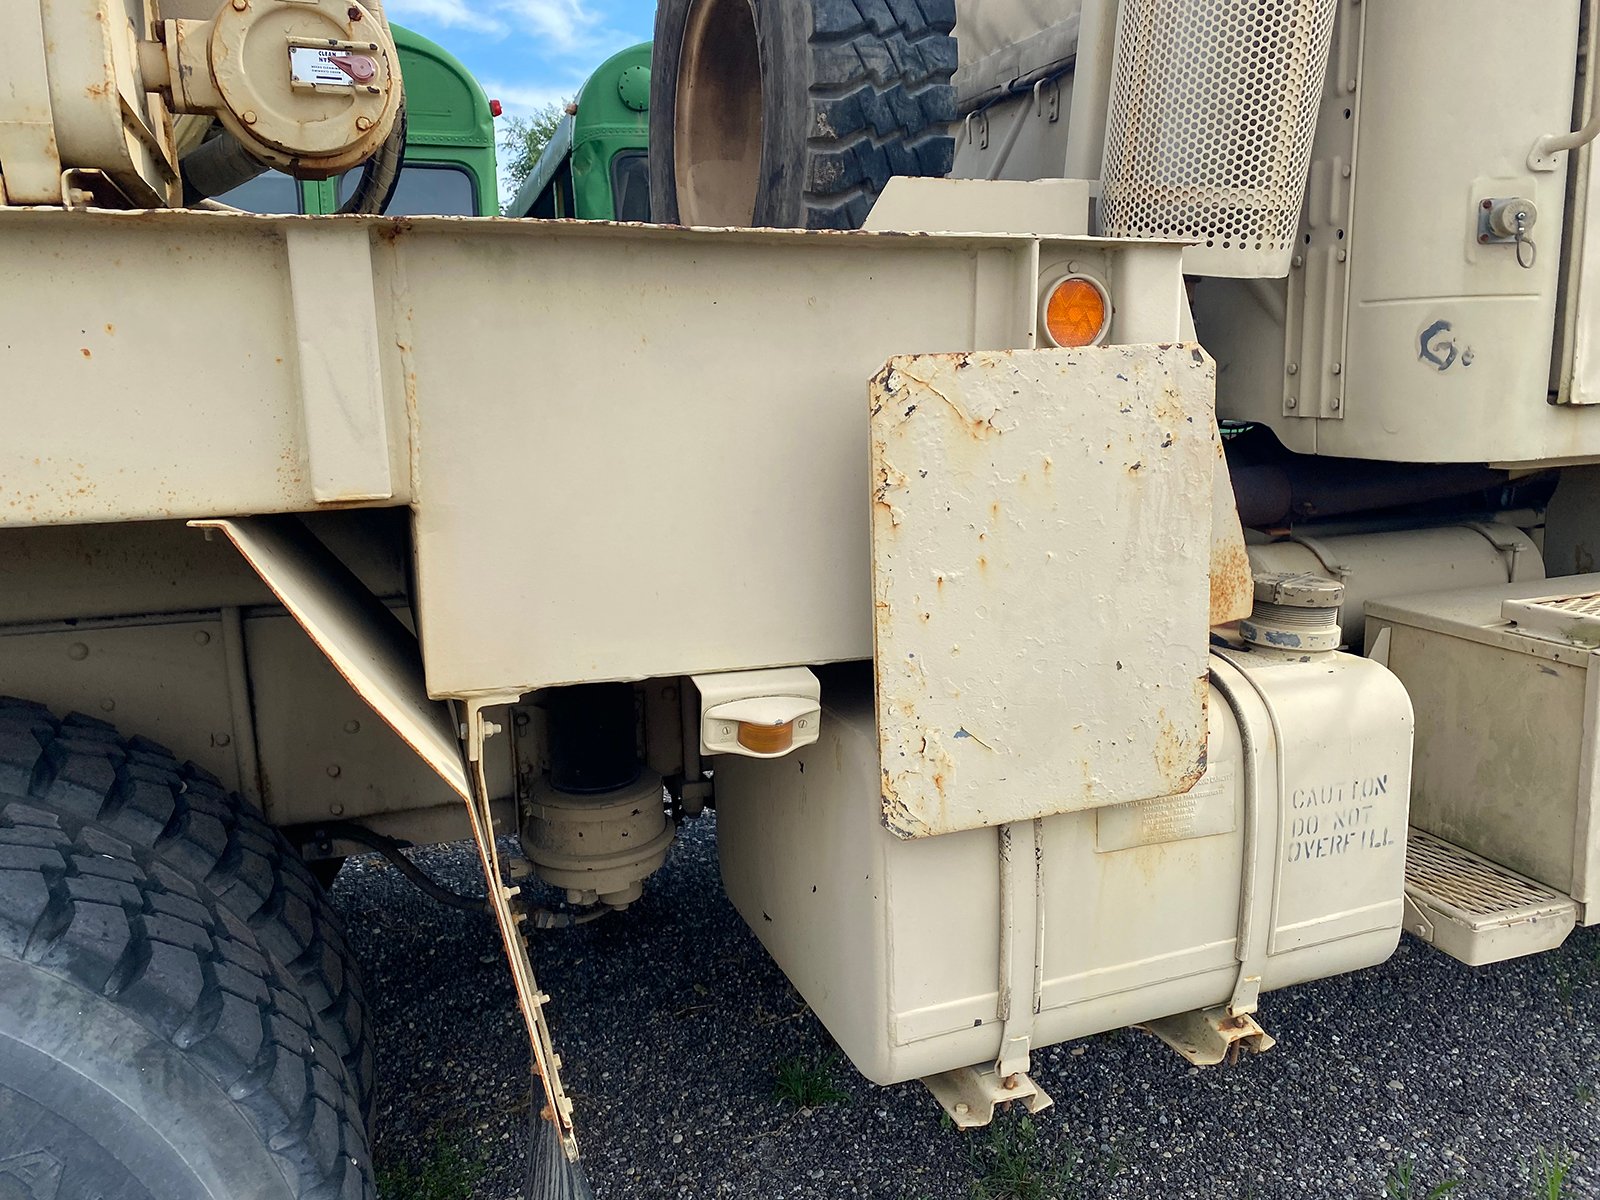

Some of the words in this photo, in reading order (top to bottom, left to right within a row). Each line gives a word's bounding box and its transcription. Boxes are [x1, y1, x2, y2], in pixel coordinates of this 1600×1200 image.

[1293, 774, 1387, 809] CAUTION
[1292, 815, 1318, 838] DO
[1333, 805, 1373, 830] NOT
[1287, 828, 1394, 862] OVERFILL
